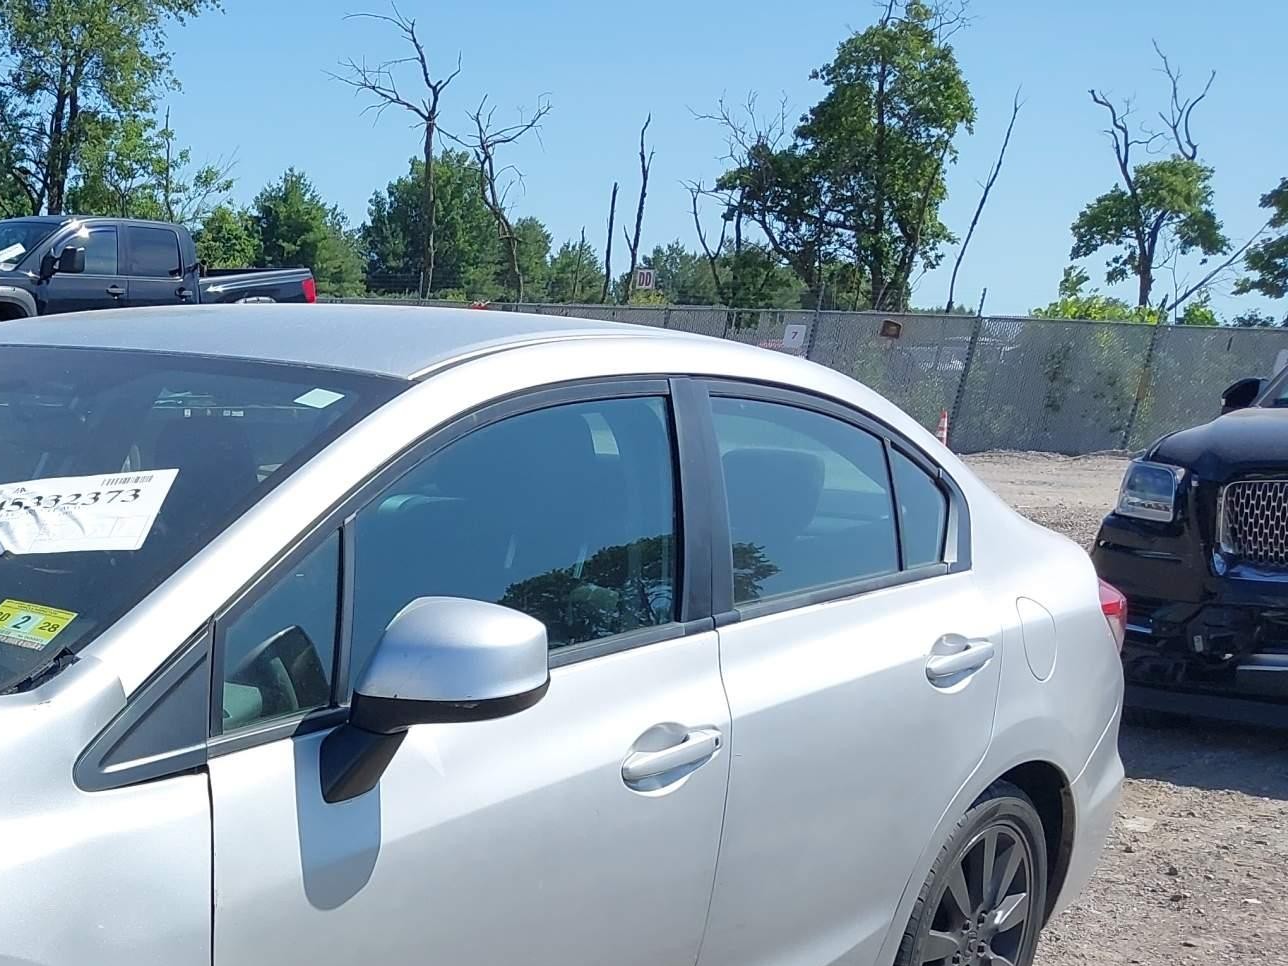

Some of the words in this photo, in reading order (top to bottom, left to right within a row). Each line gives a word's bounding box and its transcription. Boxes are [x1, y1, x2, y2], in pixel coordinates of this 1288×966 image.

[638, 271, 652, 287] DD
[11, 615, 32, 630] 2
[38, 621, 60, 633] 28
